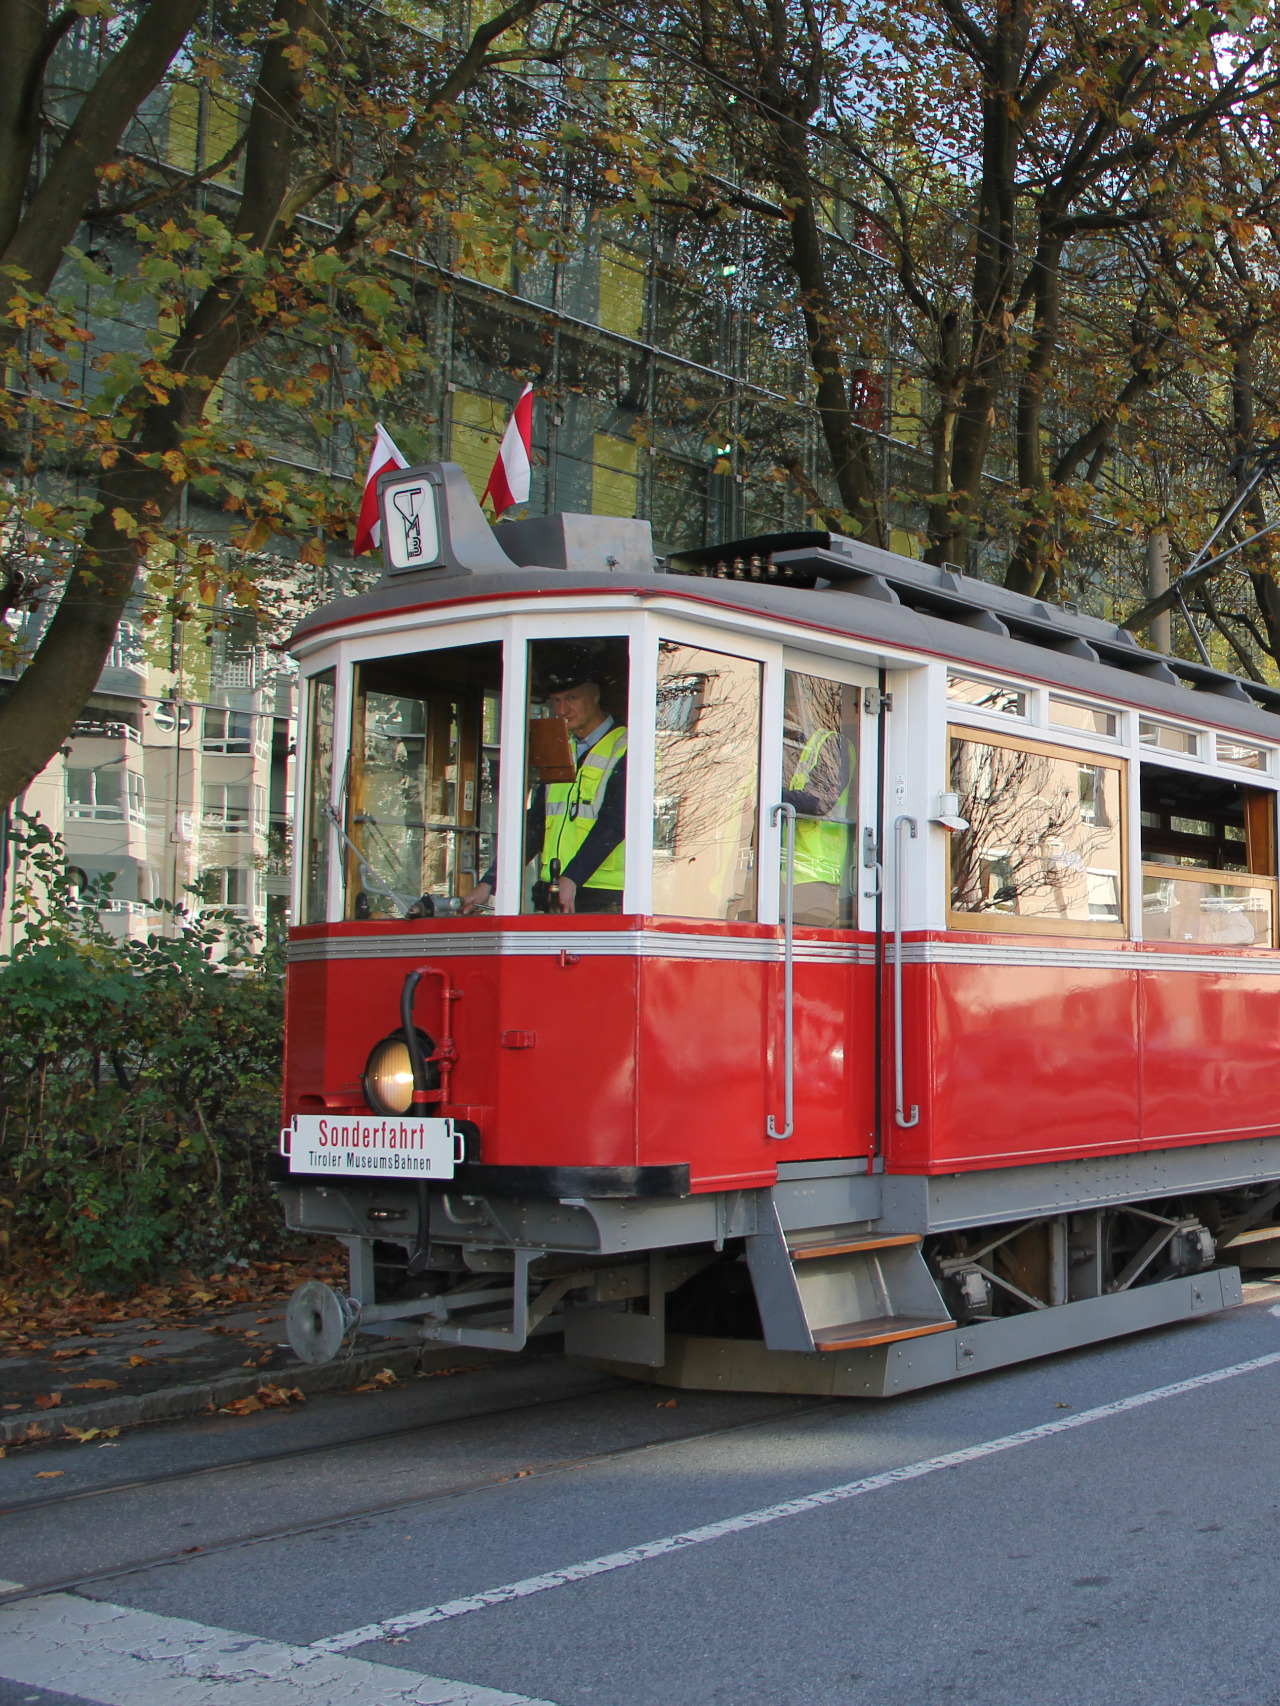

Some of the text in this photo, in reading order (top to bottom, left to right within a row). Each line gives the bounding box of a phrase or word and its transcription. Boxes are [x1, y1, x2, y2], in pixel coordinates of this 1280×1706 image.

[319, 1119, 425, 1150] Sonderfahrt
[309, 1150, 432, 1171] Tiroler MuseumsBahnen
